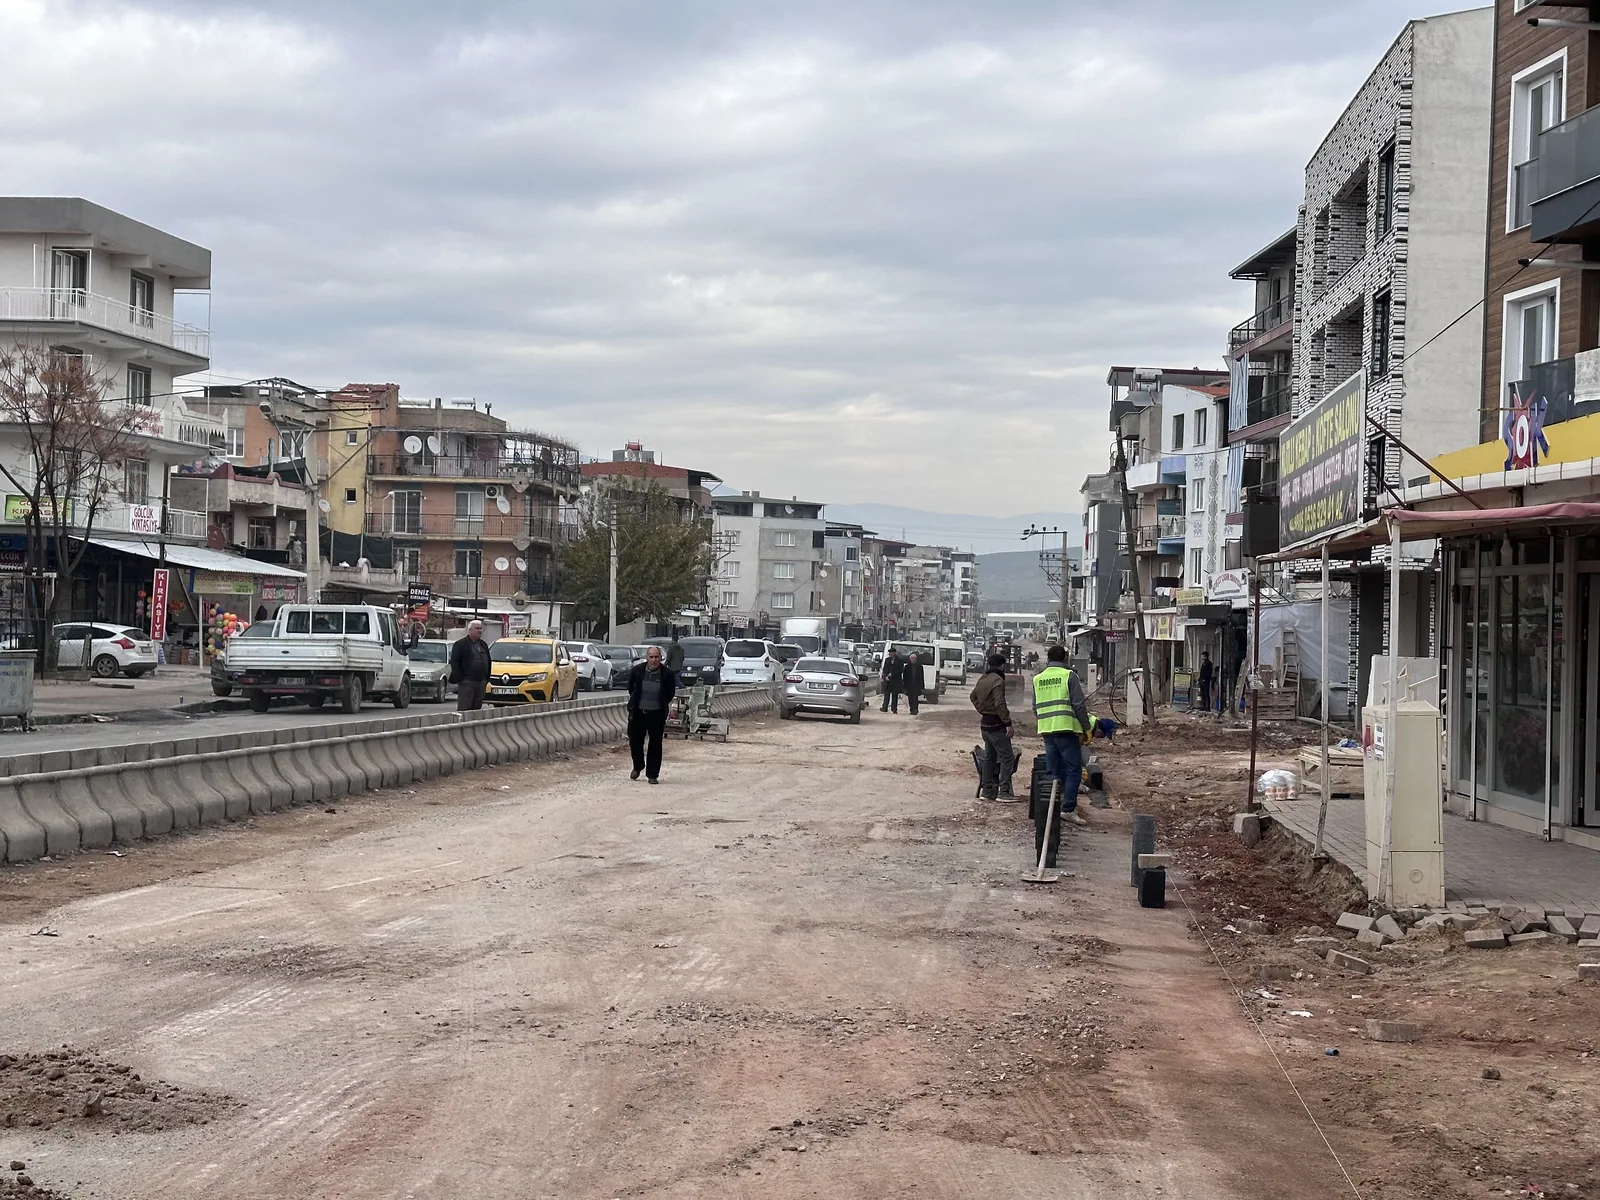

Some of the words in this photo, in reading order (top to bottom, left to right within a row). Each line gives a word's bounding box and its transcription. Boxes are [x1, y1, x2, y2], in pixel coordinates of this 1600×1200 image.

[1316, 406, 1334, 458] KÖFTE
[1335, 389, 1360, 446] SALONU
[154, 573, 164, 638] KIRTASİYE
[410, 588, 430, 596] DENİZ
